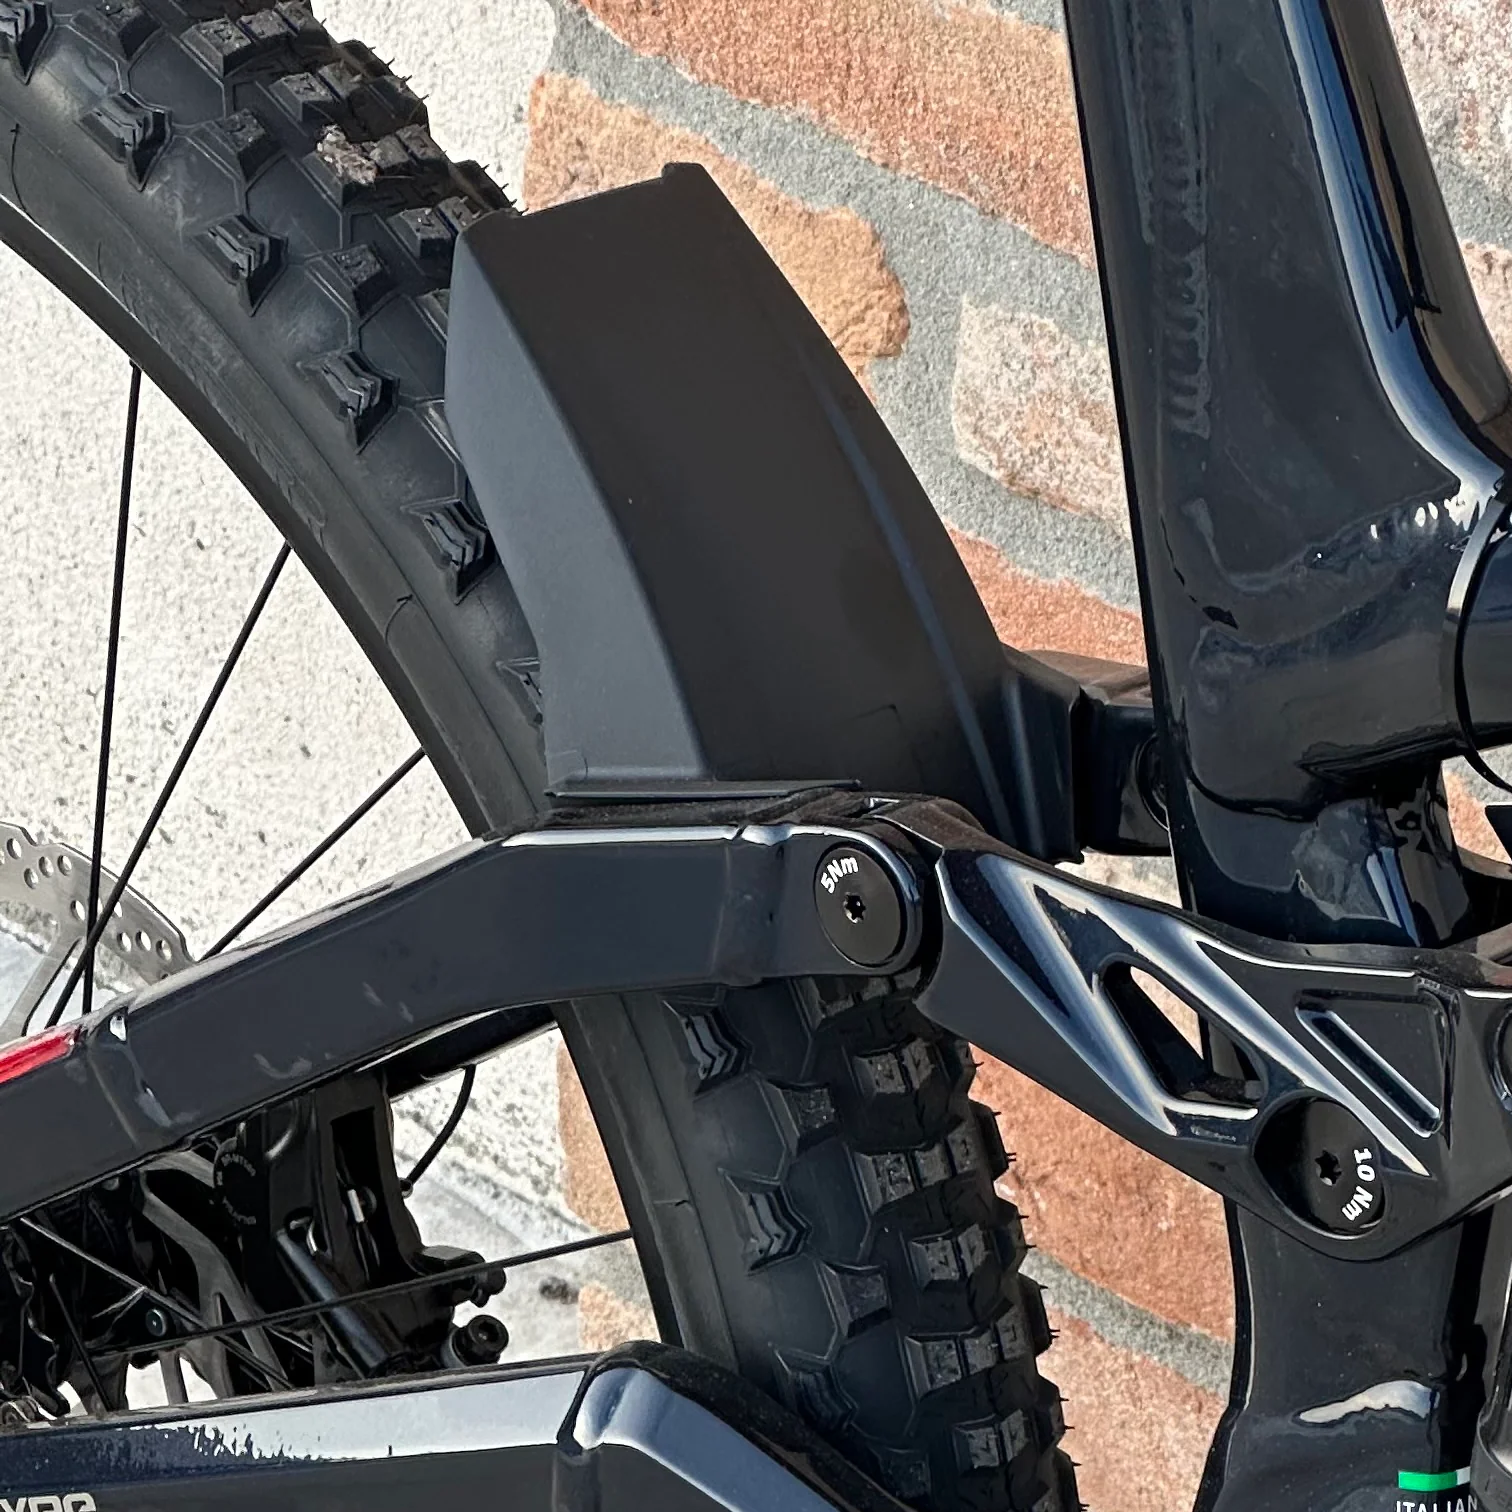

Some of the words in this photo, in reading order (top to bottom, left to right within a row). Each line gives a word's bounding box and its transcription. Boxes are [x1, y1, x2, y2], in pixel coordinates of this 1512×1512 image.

[821, 857, 859, 894] 5Nm
[1353, 1148, 1376, 1182] 10
[1341, 1185, 1374, 1221] Nm
